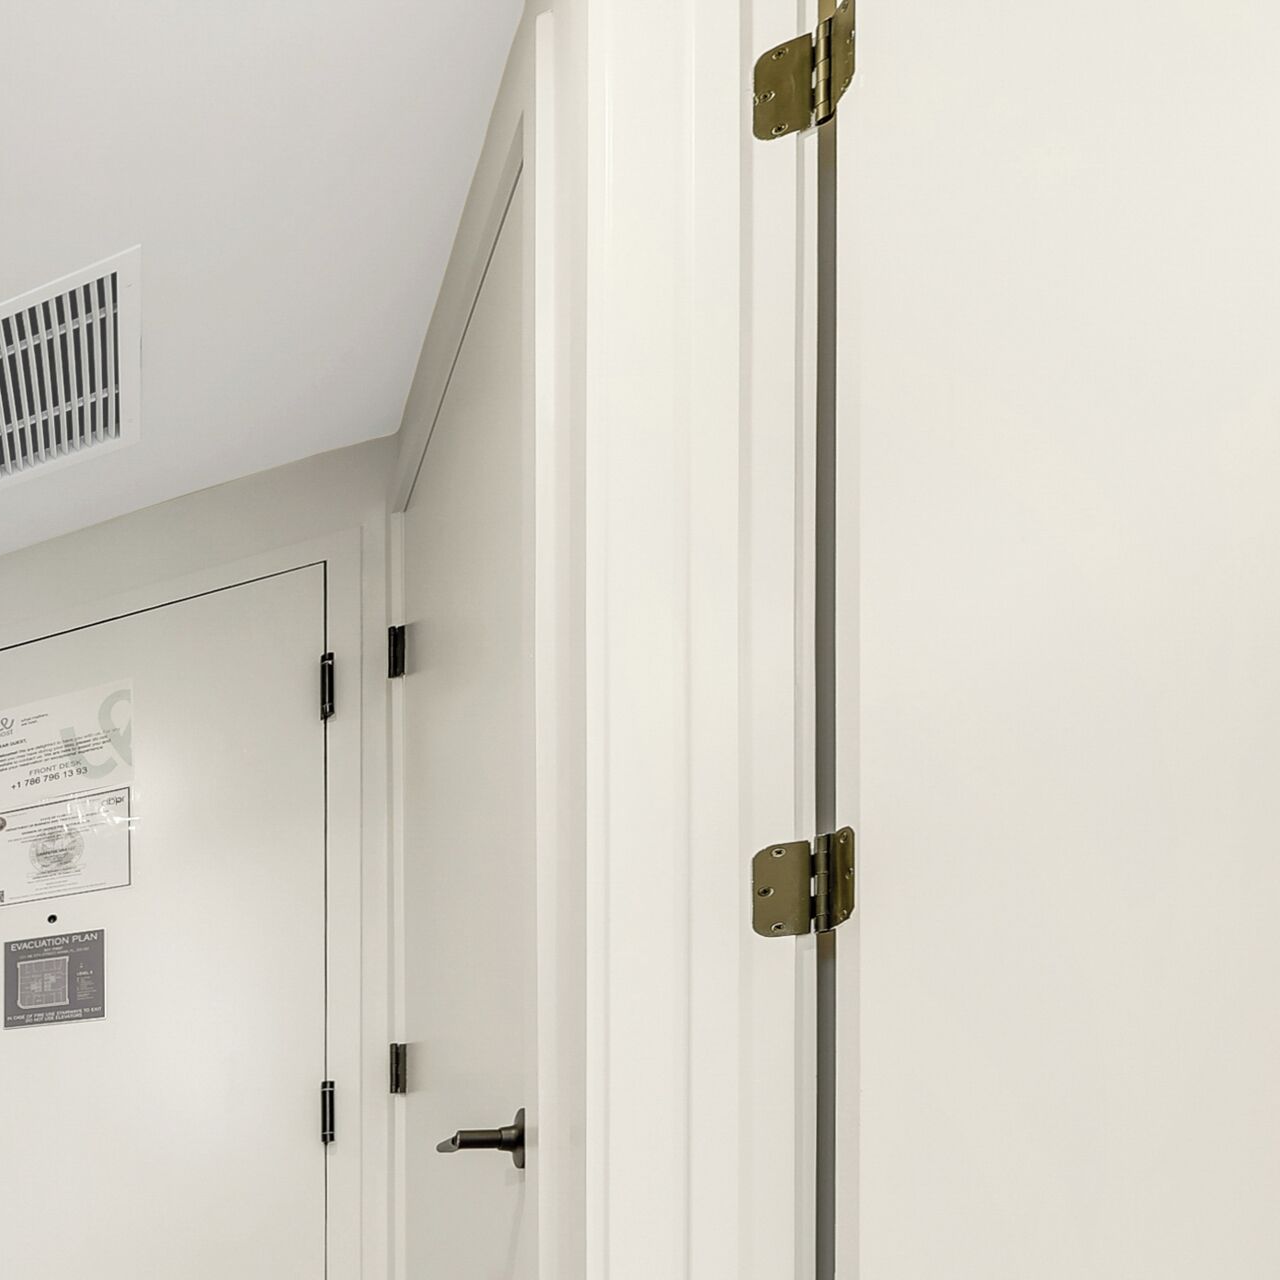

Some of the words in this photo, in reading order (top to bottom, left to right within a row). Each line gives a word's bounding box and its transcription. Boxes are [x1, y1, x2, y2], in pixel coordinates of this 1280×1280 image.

[25, 776, 40, 786] 786
[44, 772, 60, 782] 796
[64, 770, 73, 778] 13
[76, 766, 88, 776] 93
[29, 765, 56, 776] FRONT
[59, 761, 82, 770] DESK
[10, 937, 69, 951] EVACUATION
[72, 932, 98, 943] PLAN
